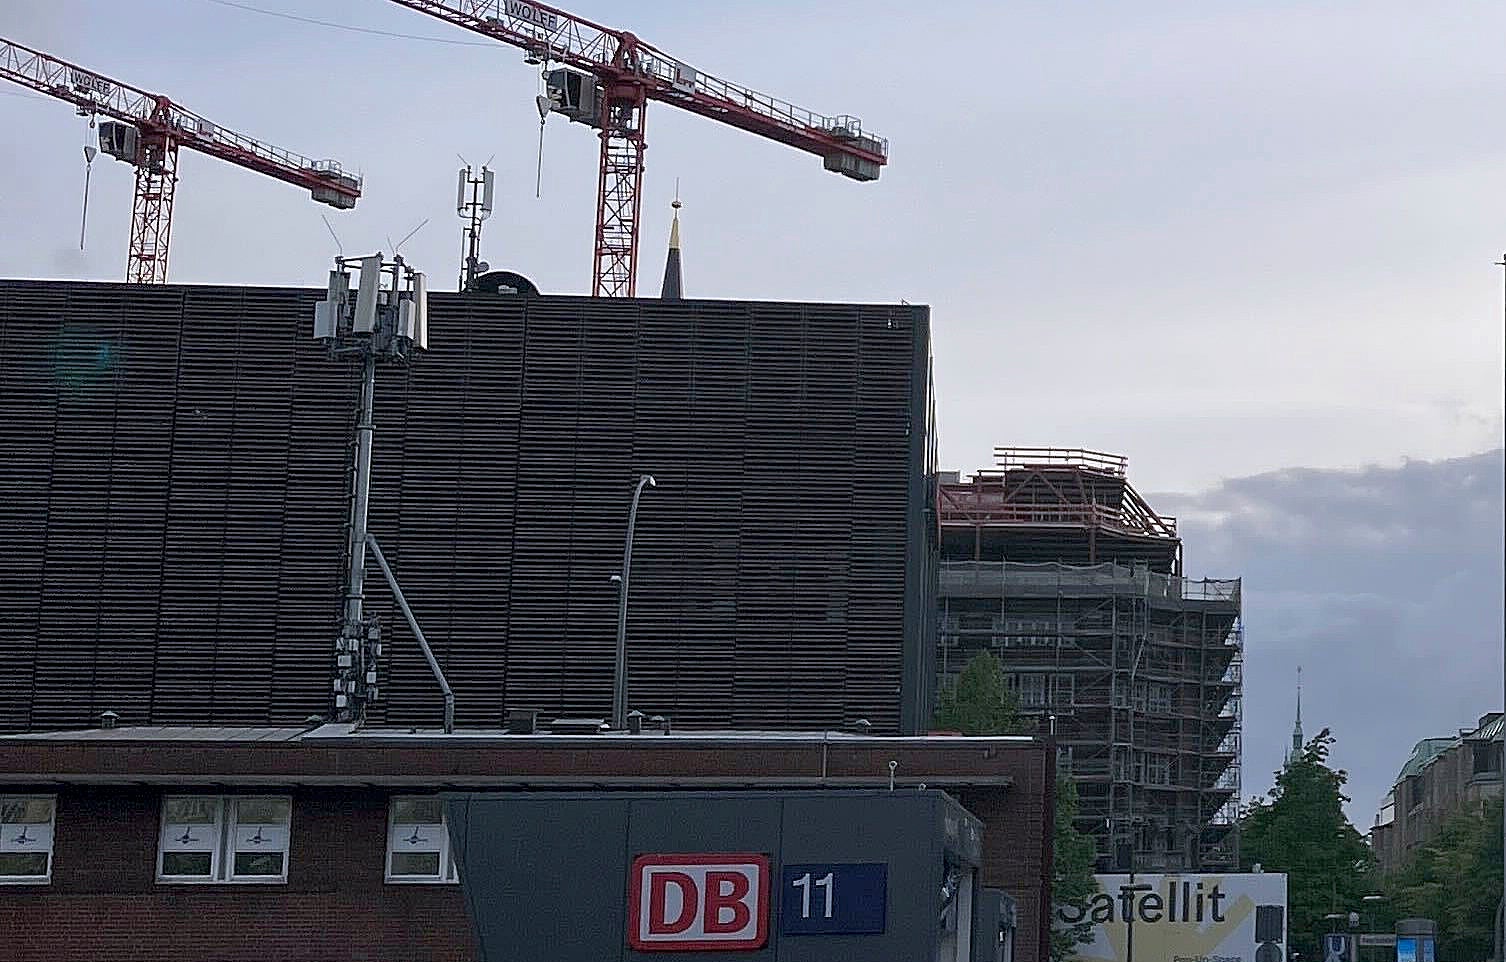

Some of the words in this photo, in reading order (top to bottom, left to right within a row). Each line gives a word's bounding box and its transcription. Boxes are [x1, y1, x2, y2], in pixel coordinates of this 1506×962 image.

[510, 0, 557, 28] WOLFF
[648, 871, 751, 935] DB
[792, 872, 834, 919] 11
